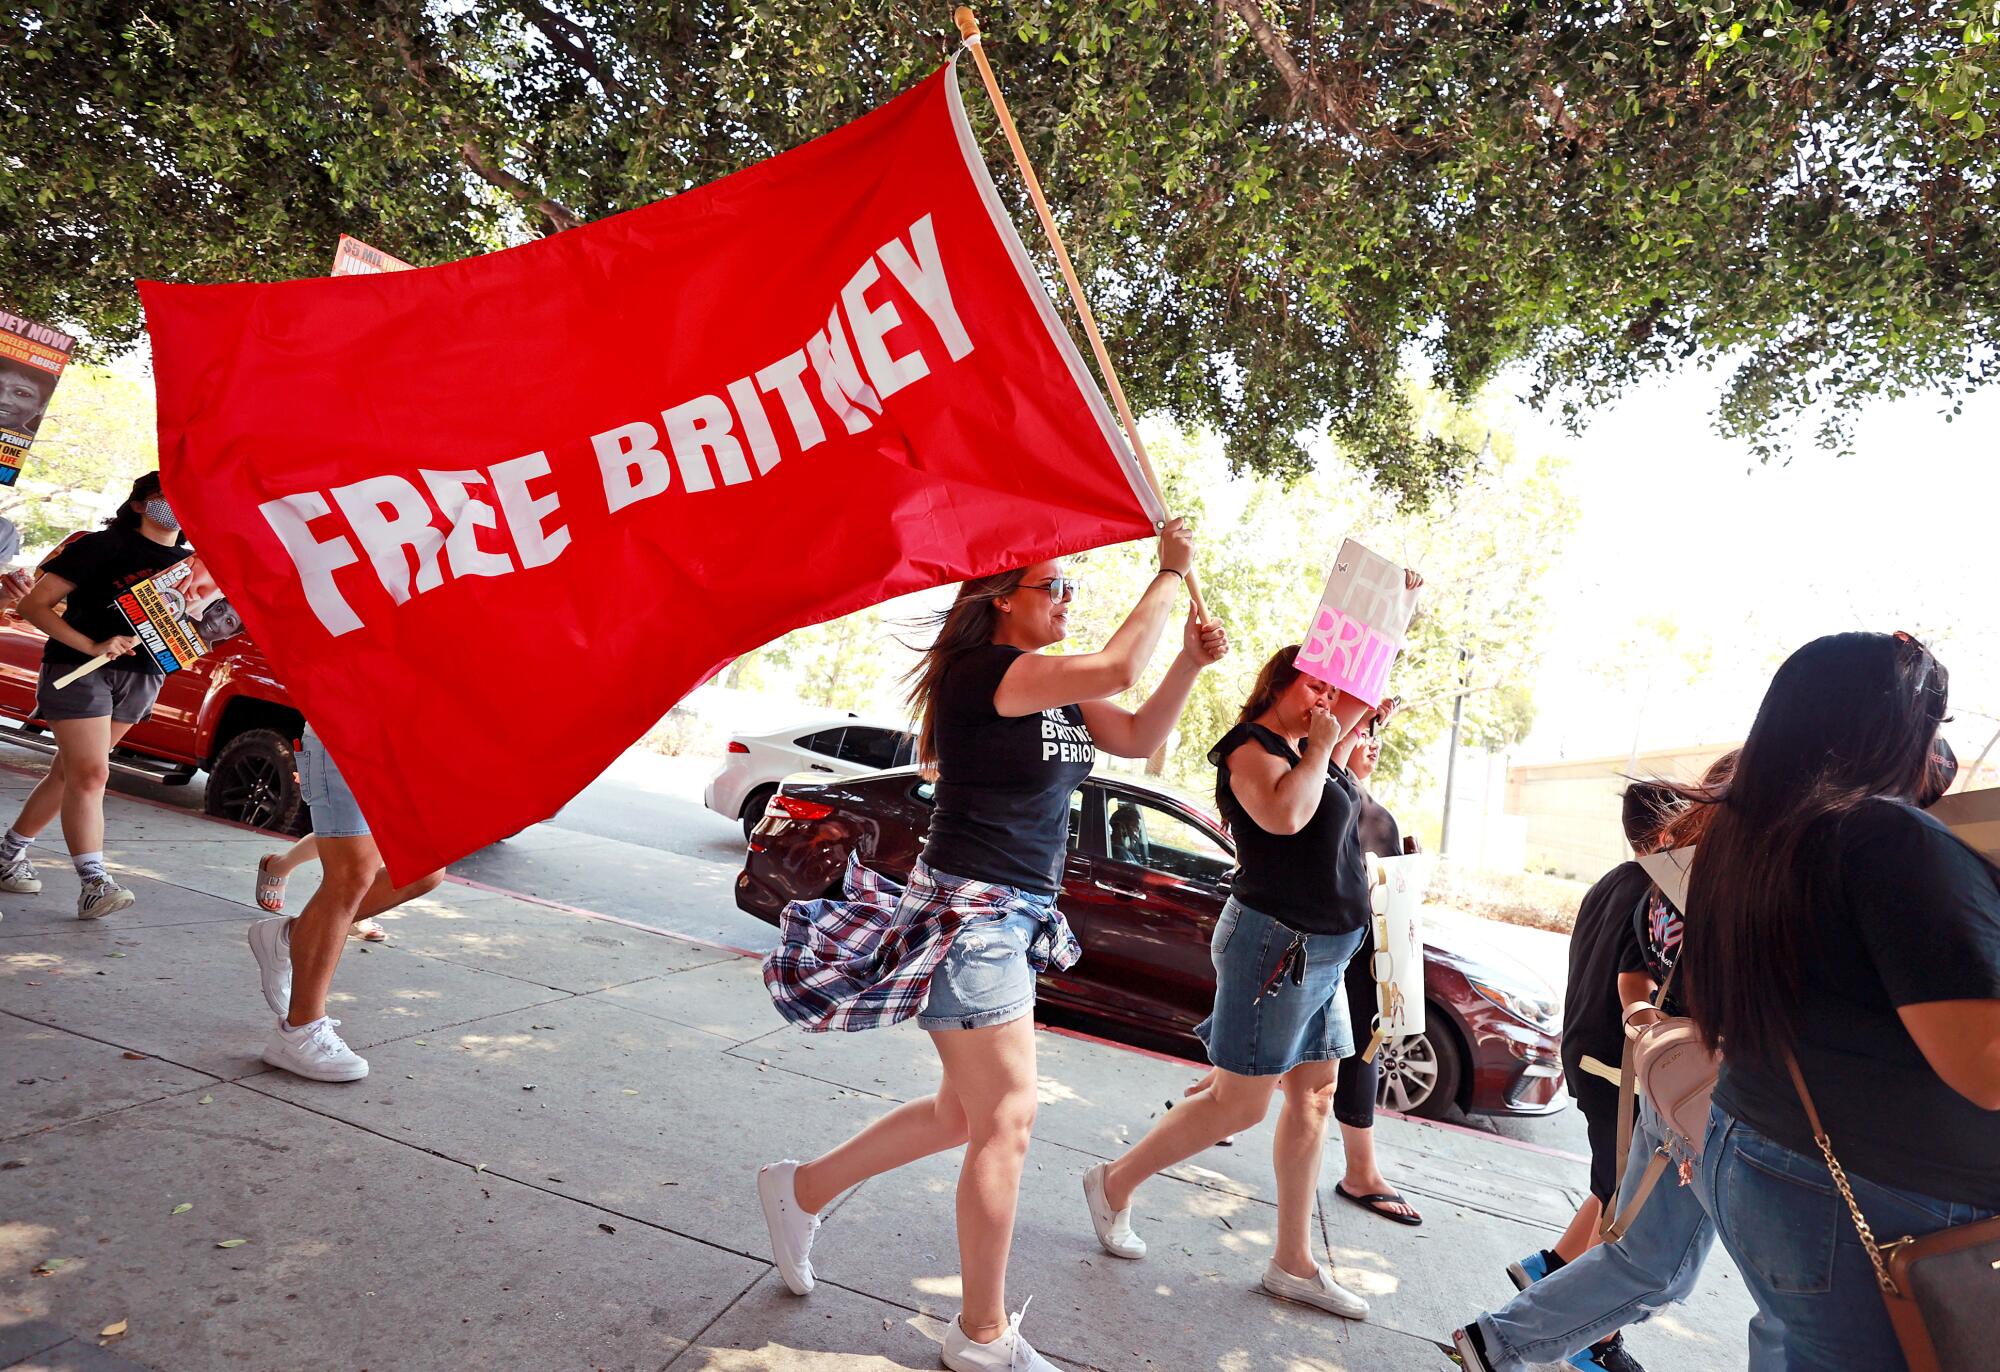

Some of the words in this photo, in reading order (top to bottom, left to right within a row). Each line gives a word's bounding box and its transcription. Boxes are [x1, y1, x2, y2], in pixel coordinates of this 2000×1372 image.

[343, 239, 360, 257] $5
[27, 322, 72, 351] NOW
[31, 343, 65, 361] COUNTY
[30, 355, 62, 373] ABUSE
[258, 451, 571, 637] FREE
[591, 213, 974, 514] BRITNEY
[1, 431, 32, 448] PENNY
[2, 445, 22, 458] ONE
[174, 562, 192, 581] 13
[135, 588, 150, 606] PERSON
[146, 605, 159, 620] TAKES
[155, 618, 171, 638] CONTROL
[178, 653, 187, 662] LIFE
[142, 583, 154, 597] THIS
[153, 600, 166, 616] WHAT
[162, 614, 180, 637] HAPPENS
[175, 634, 189, 650] WHEN
[184, 648, 194, 659] ONE
